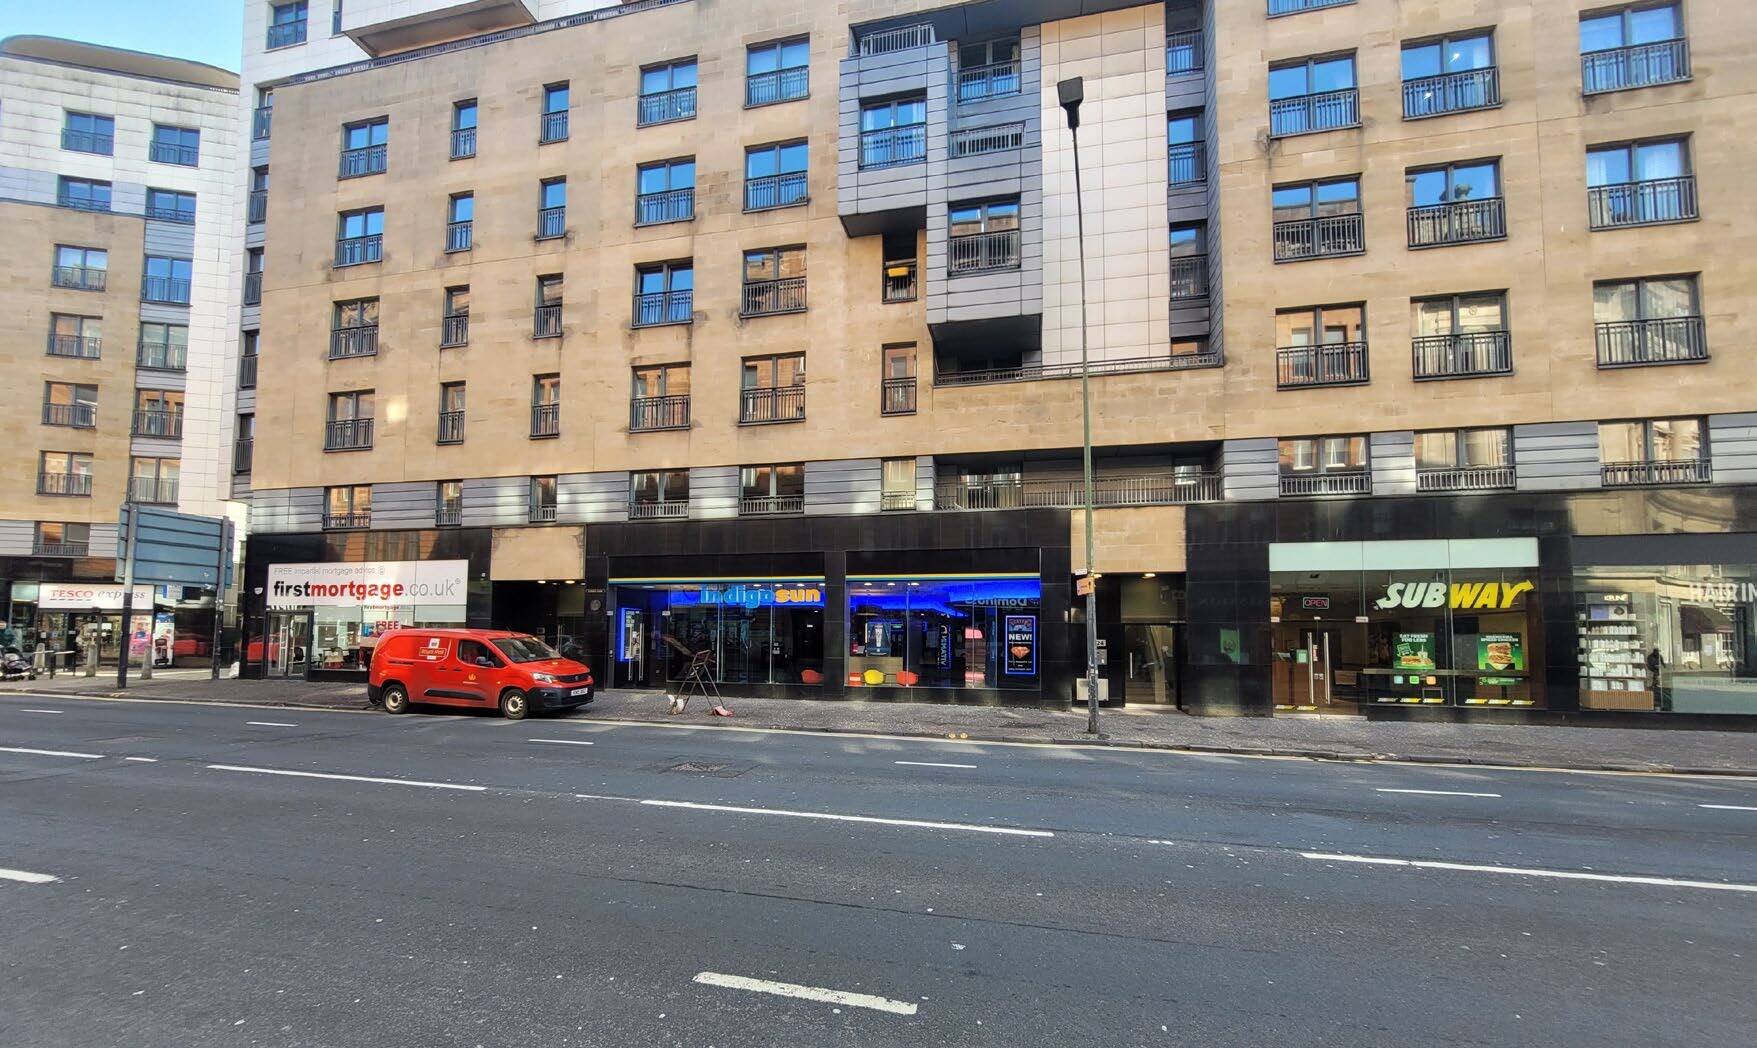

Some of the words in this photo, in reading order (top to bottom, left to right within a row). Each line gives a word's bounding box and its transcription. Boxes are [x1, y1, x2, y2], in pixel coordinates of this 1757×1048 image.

[274, 567, 292, 575] FREE
[50, 589, 94, 598] TESCO
[97, 590, 145, 600] expss
[1376, 580, 1534, 609] SUBWAY
[1304, 599, 1328, 607] OPEN
[1008, 633, 1033, 641] NEW!
